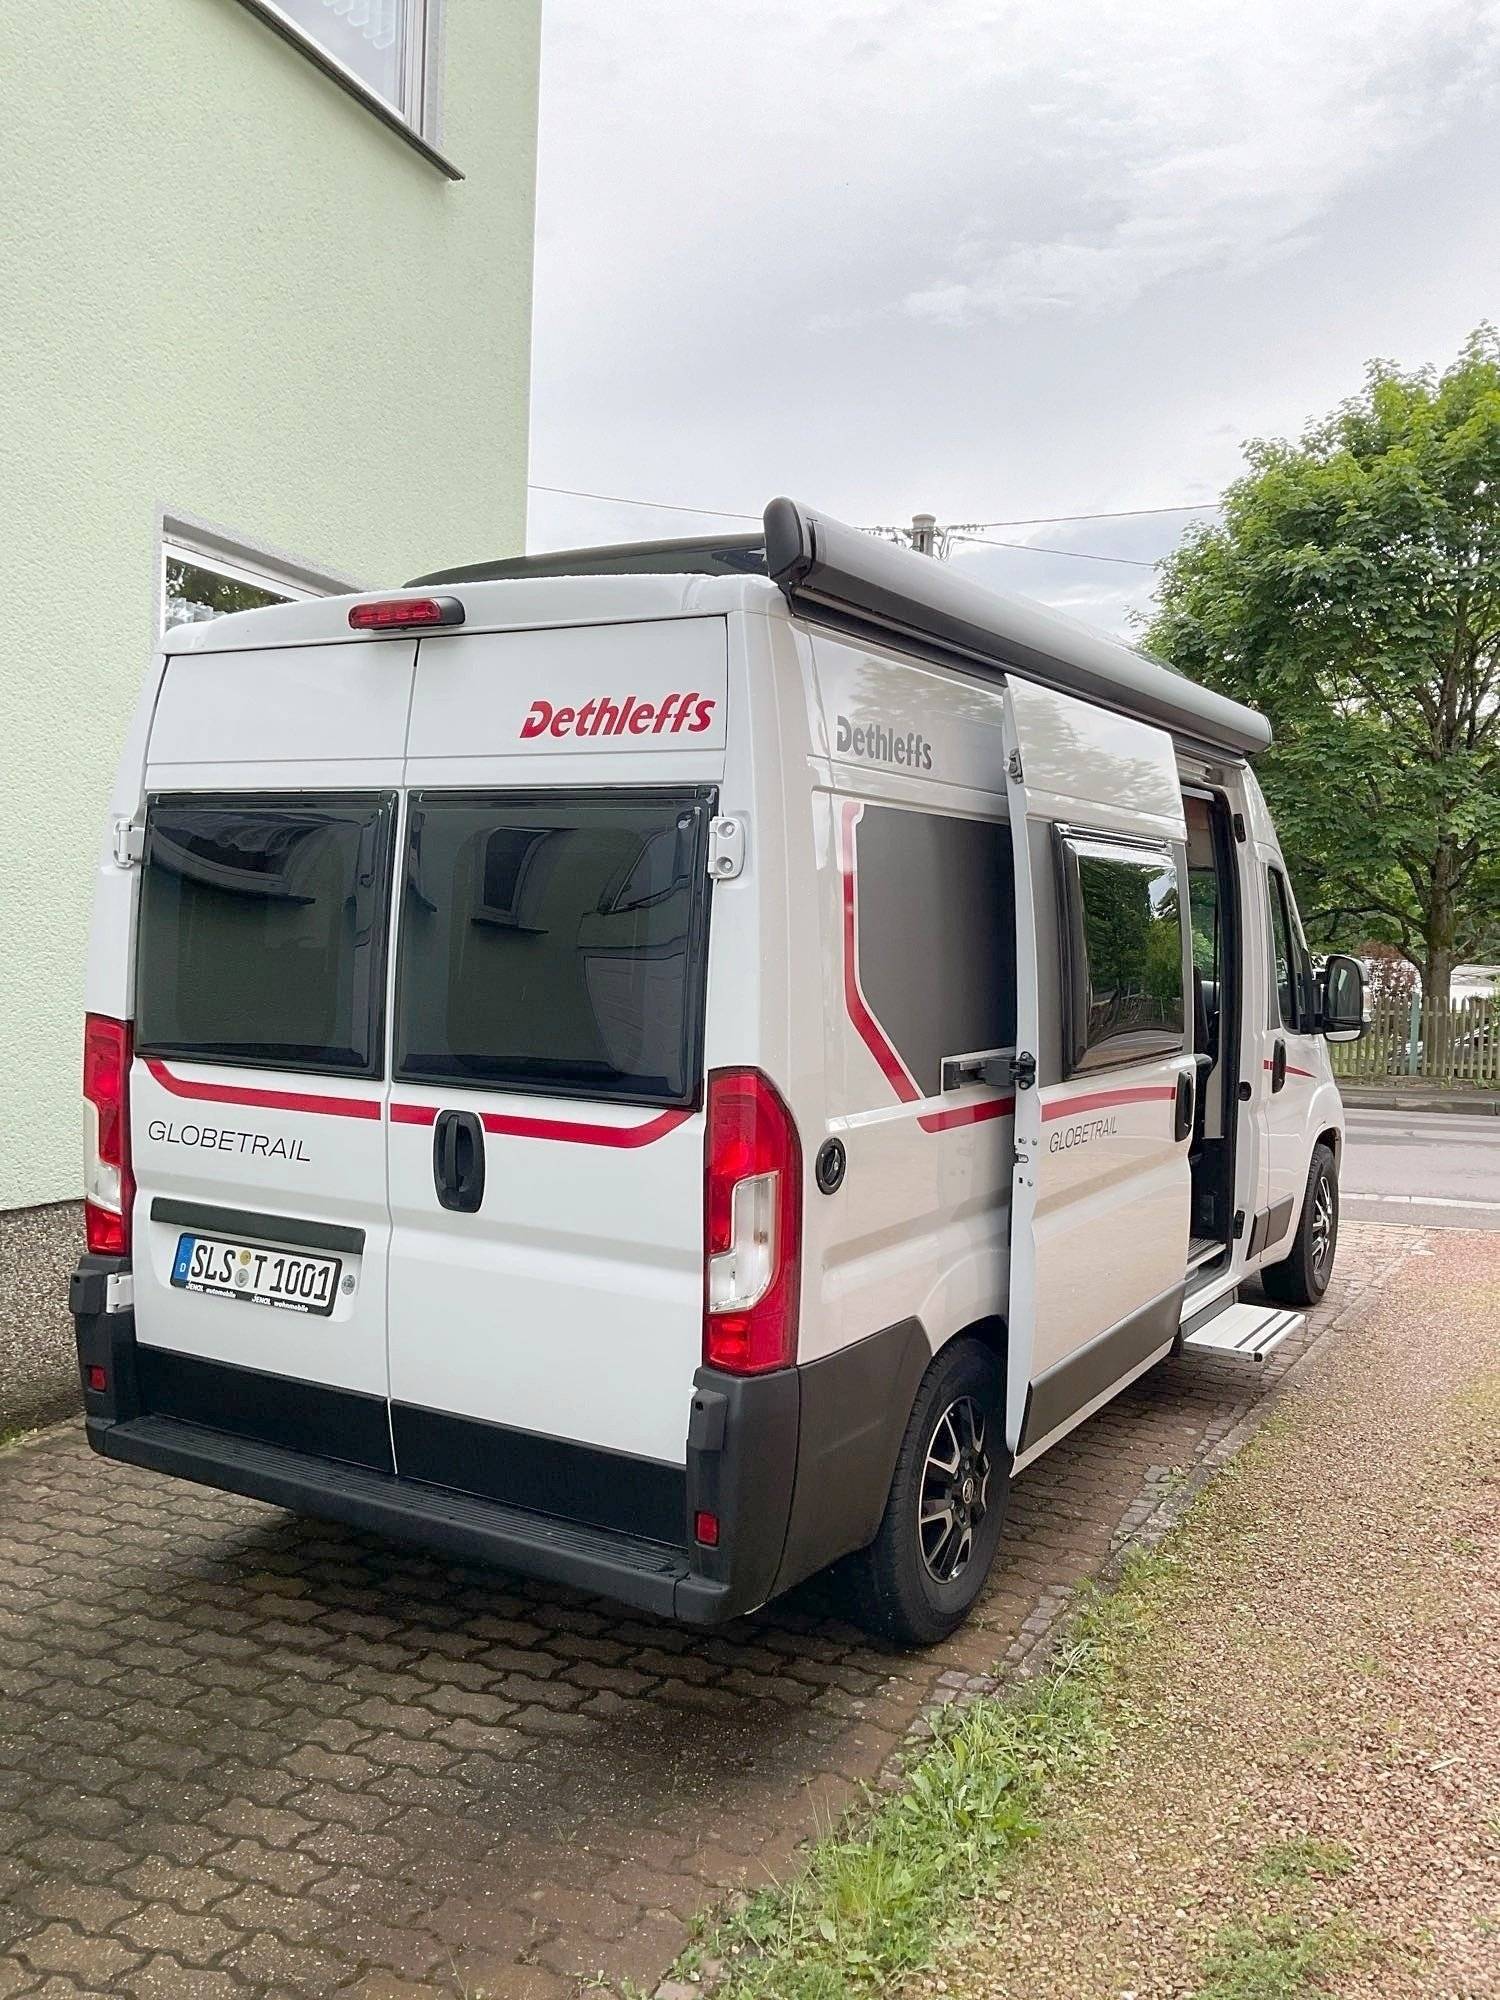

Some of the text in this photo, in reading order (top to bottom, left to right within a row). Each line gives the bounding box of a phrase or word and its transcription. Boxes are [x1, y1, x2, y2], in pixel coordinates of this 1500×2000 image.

[519, 692, 716, 739] Dethleffs
[836, 715, 932, 770] Dethleffs
[148, 1120, 311, 1162] GLOBETRAIL
[1049, 1116, 1118, 1153] GLOBETRAIL
[179, 1262, 186, 1273] D
[190, 1244, 331, 1302] SLS T 1001
[273, 1300, 309, 1313] wohnmobile
